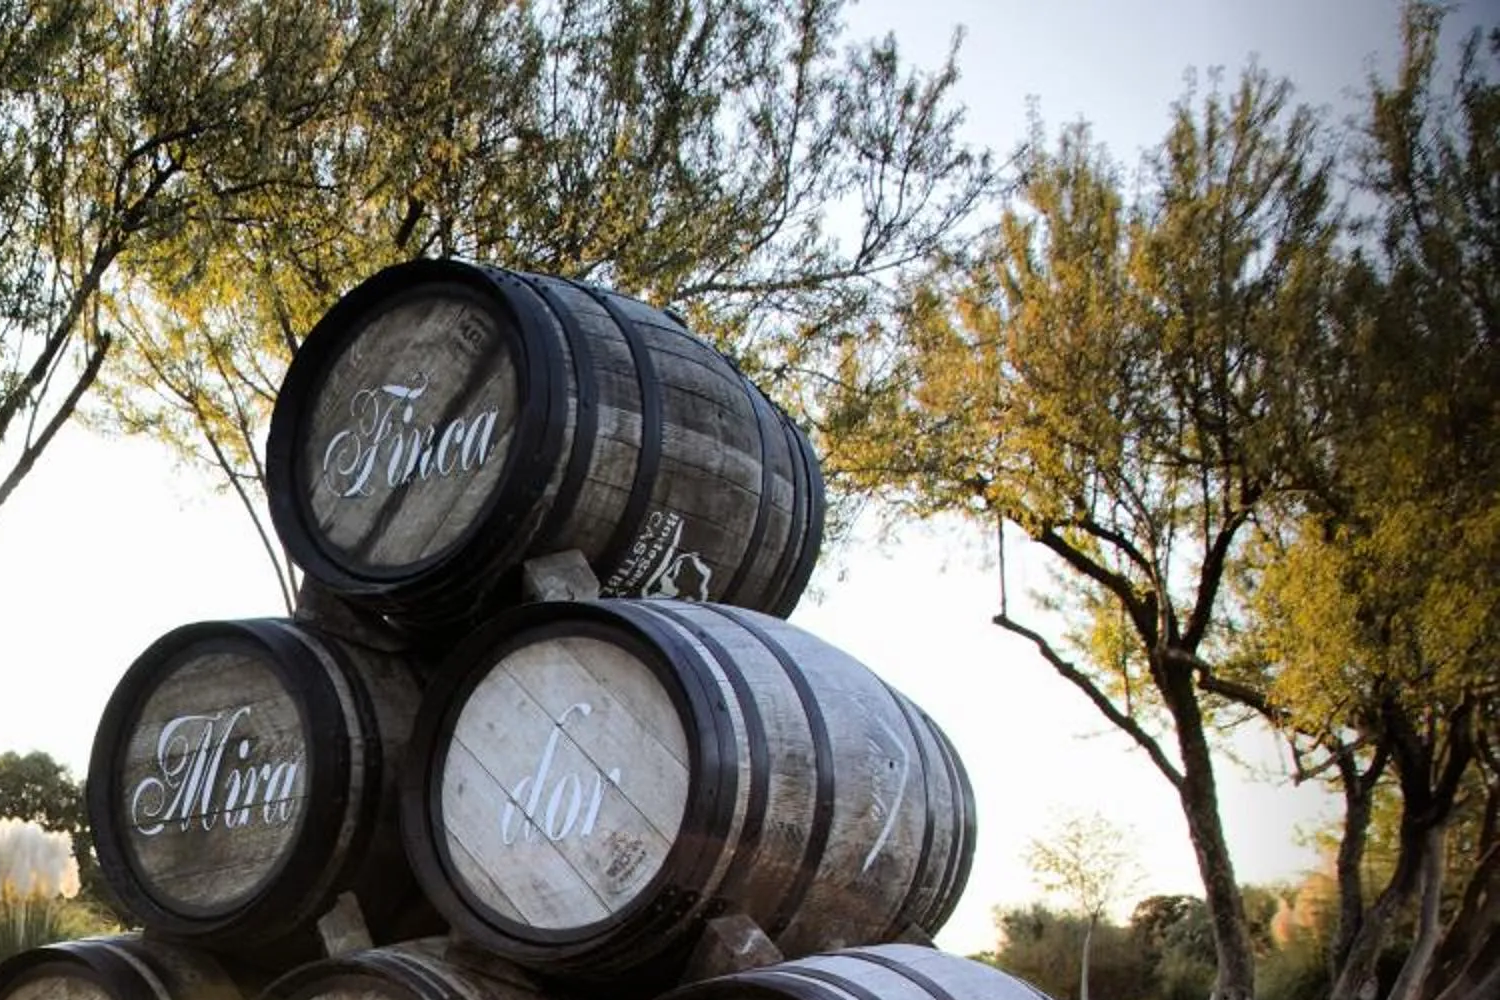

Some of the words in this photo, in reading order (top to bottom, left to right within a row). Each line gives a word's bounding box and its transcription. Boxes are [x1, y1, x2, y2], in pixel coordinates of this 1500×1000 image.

[324, 372, 499, 497] Finca
[132, 706, 298, 835] Mira
[502, 703, 621, 846] dor
